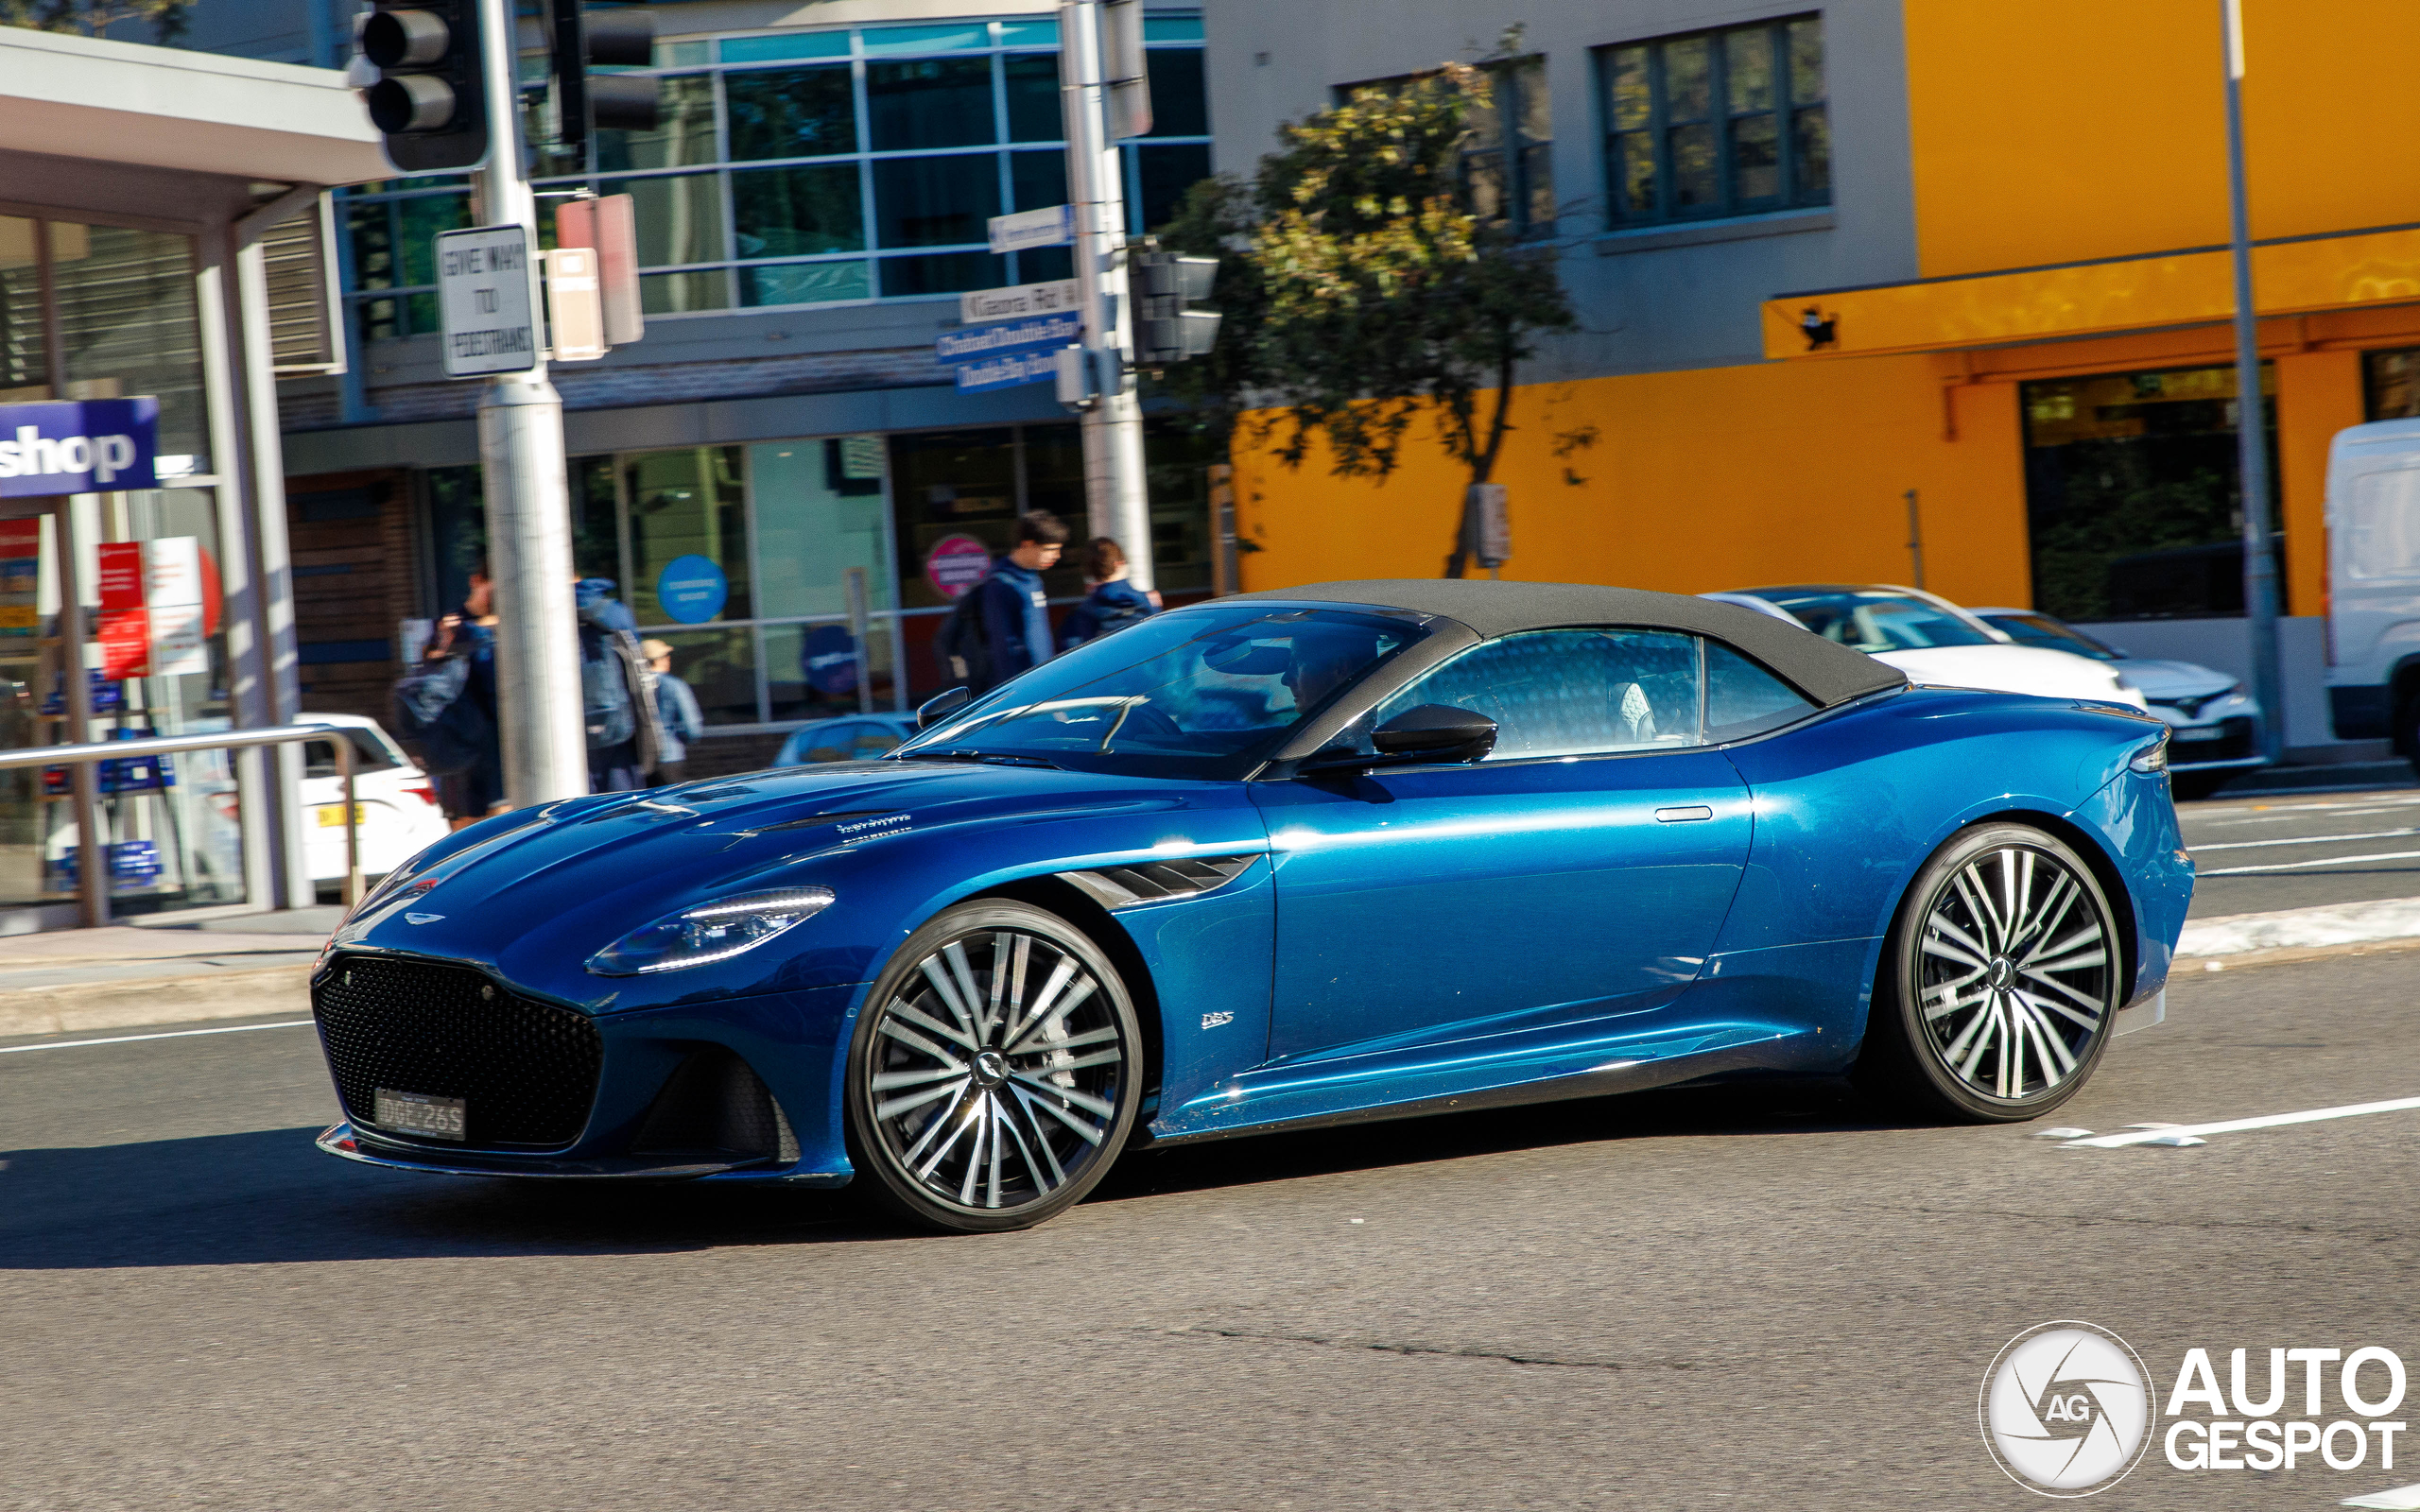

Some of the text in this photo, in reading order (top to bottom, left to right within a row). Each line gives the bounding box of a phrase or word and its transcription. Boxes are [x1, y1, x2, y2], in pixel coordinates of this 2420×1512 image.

[441, 242, 526, 276] GIVE WAY
[472, 288, 499, 315] TO
[1031, 288, 1058, 310] Rd
[448, 325, 533, 358] PEDESTRIANS
[0, 425, 136, 483] shop
[1201, 1010, 1235, 1030] DBS
